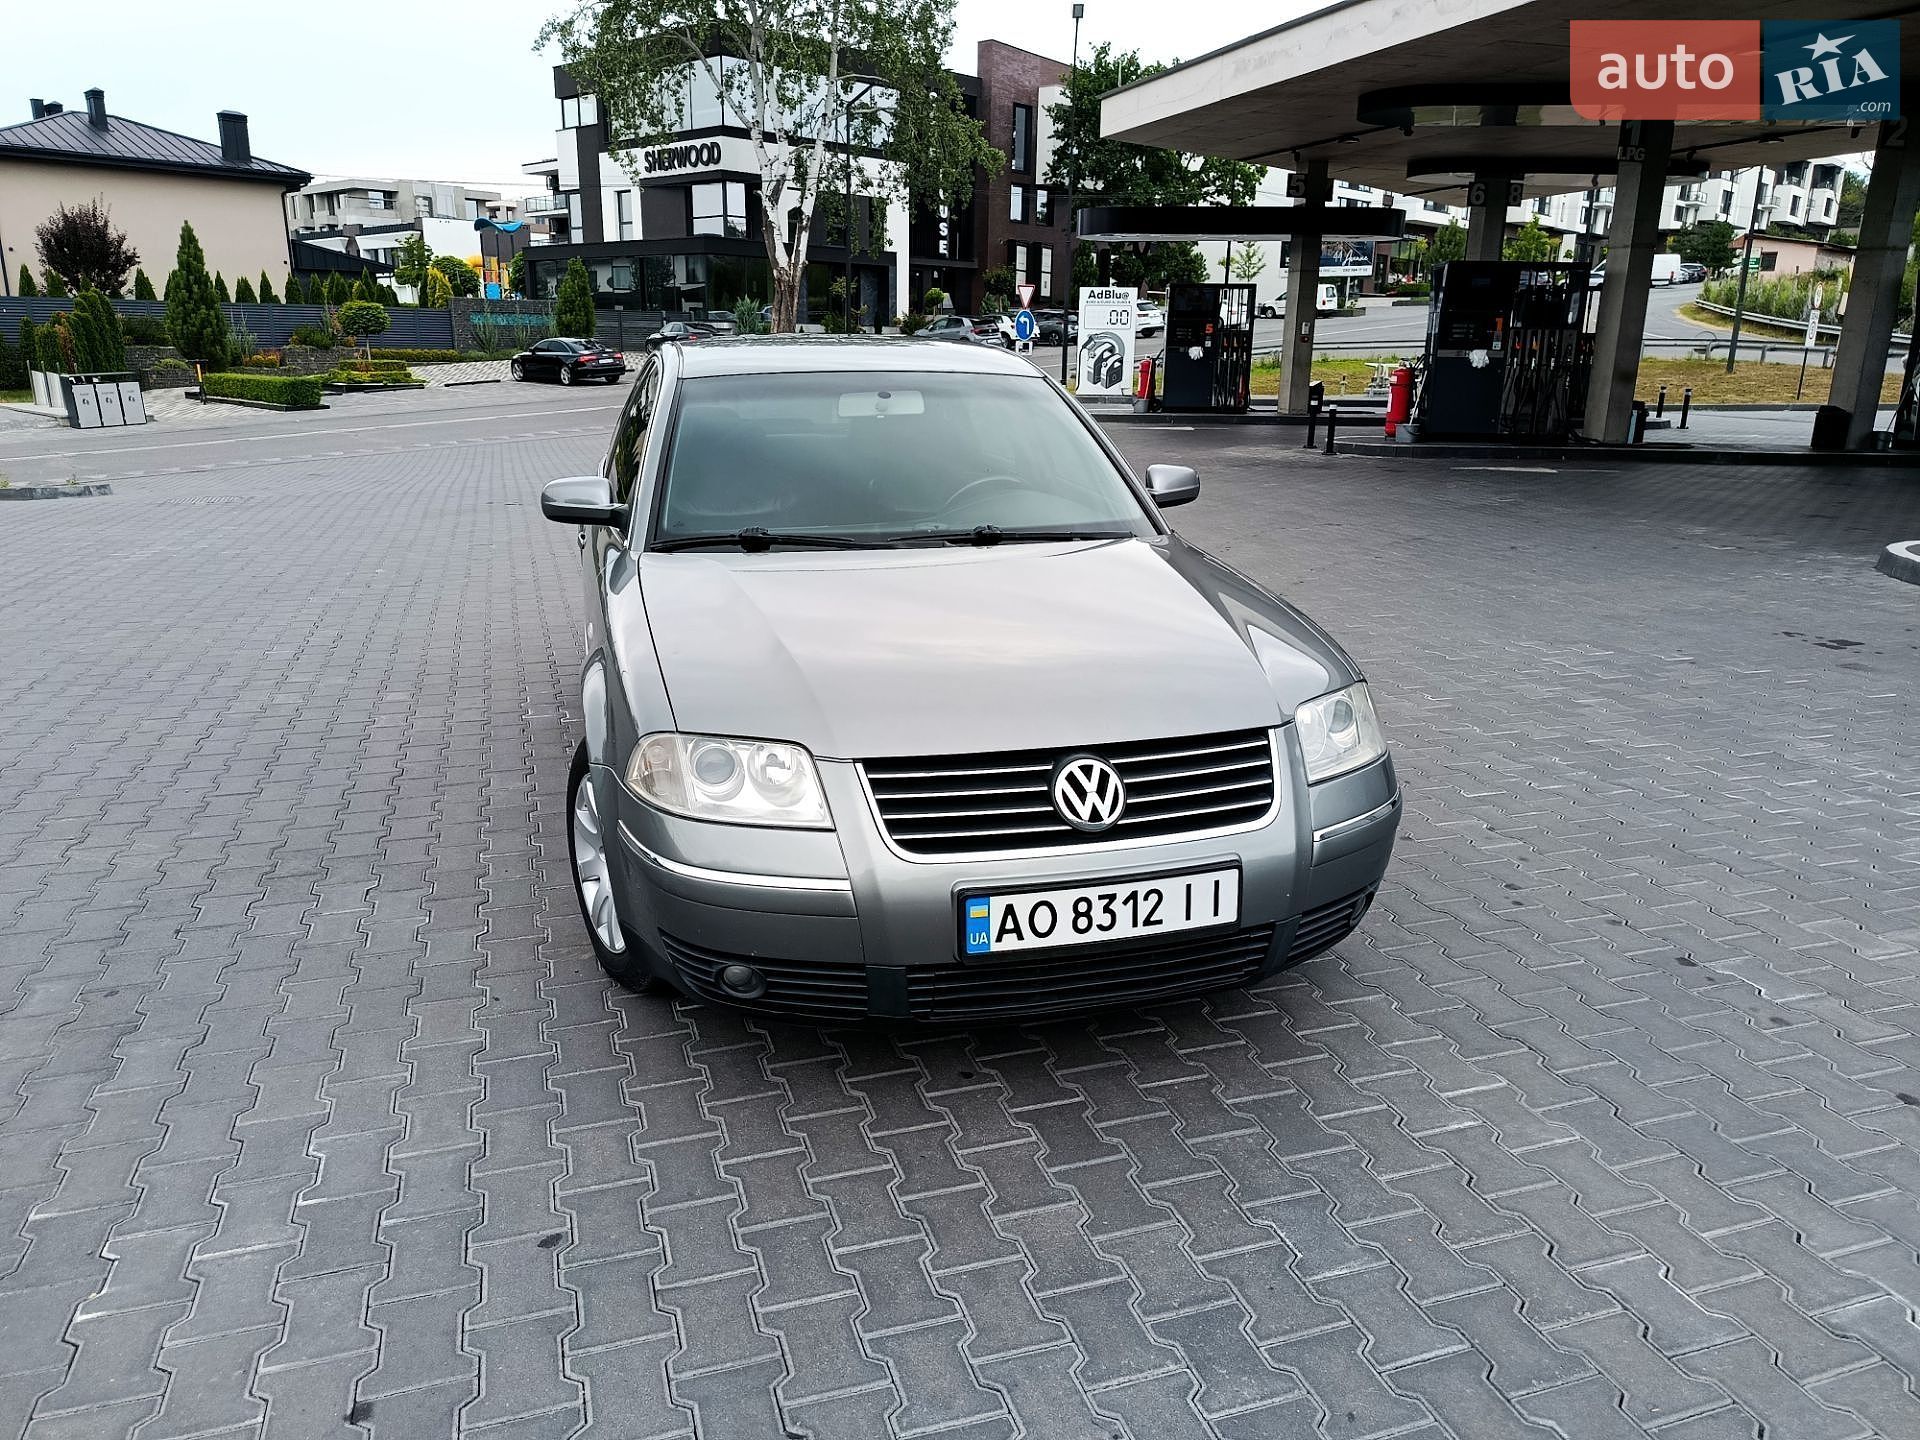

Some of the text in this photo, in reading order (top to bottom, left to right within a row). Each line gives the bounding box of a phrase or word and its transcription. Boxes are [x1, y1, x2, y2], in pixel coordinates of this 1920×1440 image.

[644, 141, 722, 173] SHERWOOD
[1289, 174, 1306, 197] 5
[1470, 183, 1486, 205] 6
[1509, 183, 1522, 206] 8
[995, 900, 1059, 943] AO
[1071, 888, 1165, 935] 8312
[969, 931, 989, 945] UA
